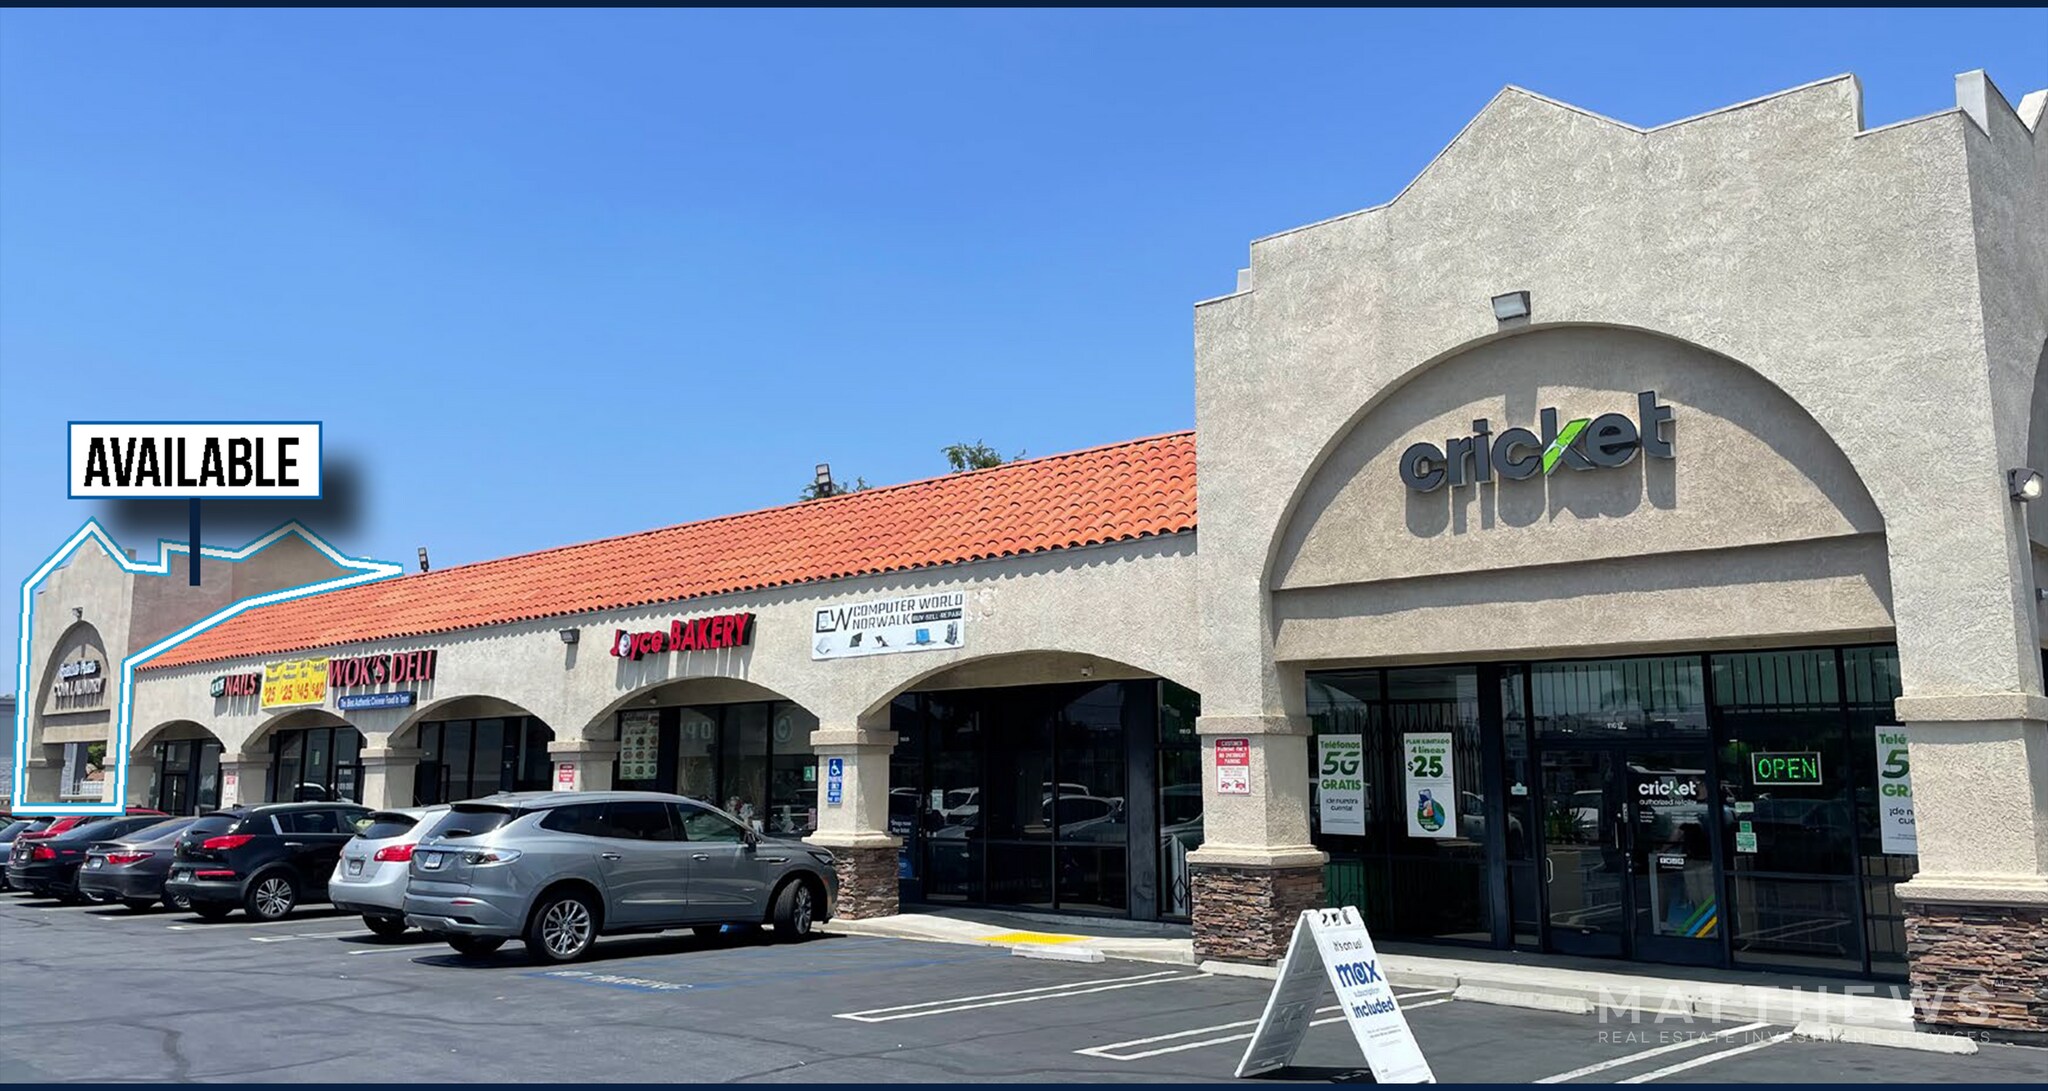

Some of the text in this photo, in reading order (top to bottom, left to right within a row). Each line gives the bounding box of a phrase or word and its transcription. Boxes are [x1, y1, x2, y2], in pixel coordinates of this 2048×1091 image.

[1400, 390, 1674, 492] cricket
[853, 594, 963, 617] COMPUTER WORLD
[852, 613, 911, 630] NORWALK
[610, 612, 752, 661] Joyce BAKERY
[329, 654, 387, 688] WOK'S
[391, 649, 434, 683] DELI
[225, 673, 257, 697] NAILS
[1320, 740, 1360, 749] Teléfonos
[1321, 751, 1360, 775] 5G
[1407, 755, 1444, 778] $25
[1758, 757, 1816, 779] OPEN
[1881, 749, 1910, 778] 5
[1321, 779, 1361, 790] GRATIS
[1638, 780, 1697, 795] cricket
[1335, 959, 1382, 988] max
[1351, 996, 1396, 1018] included
